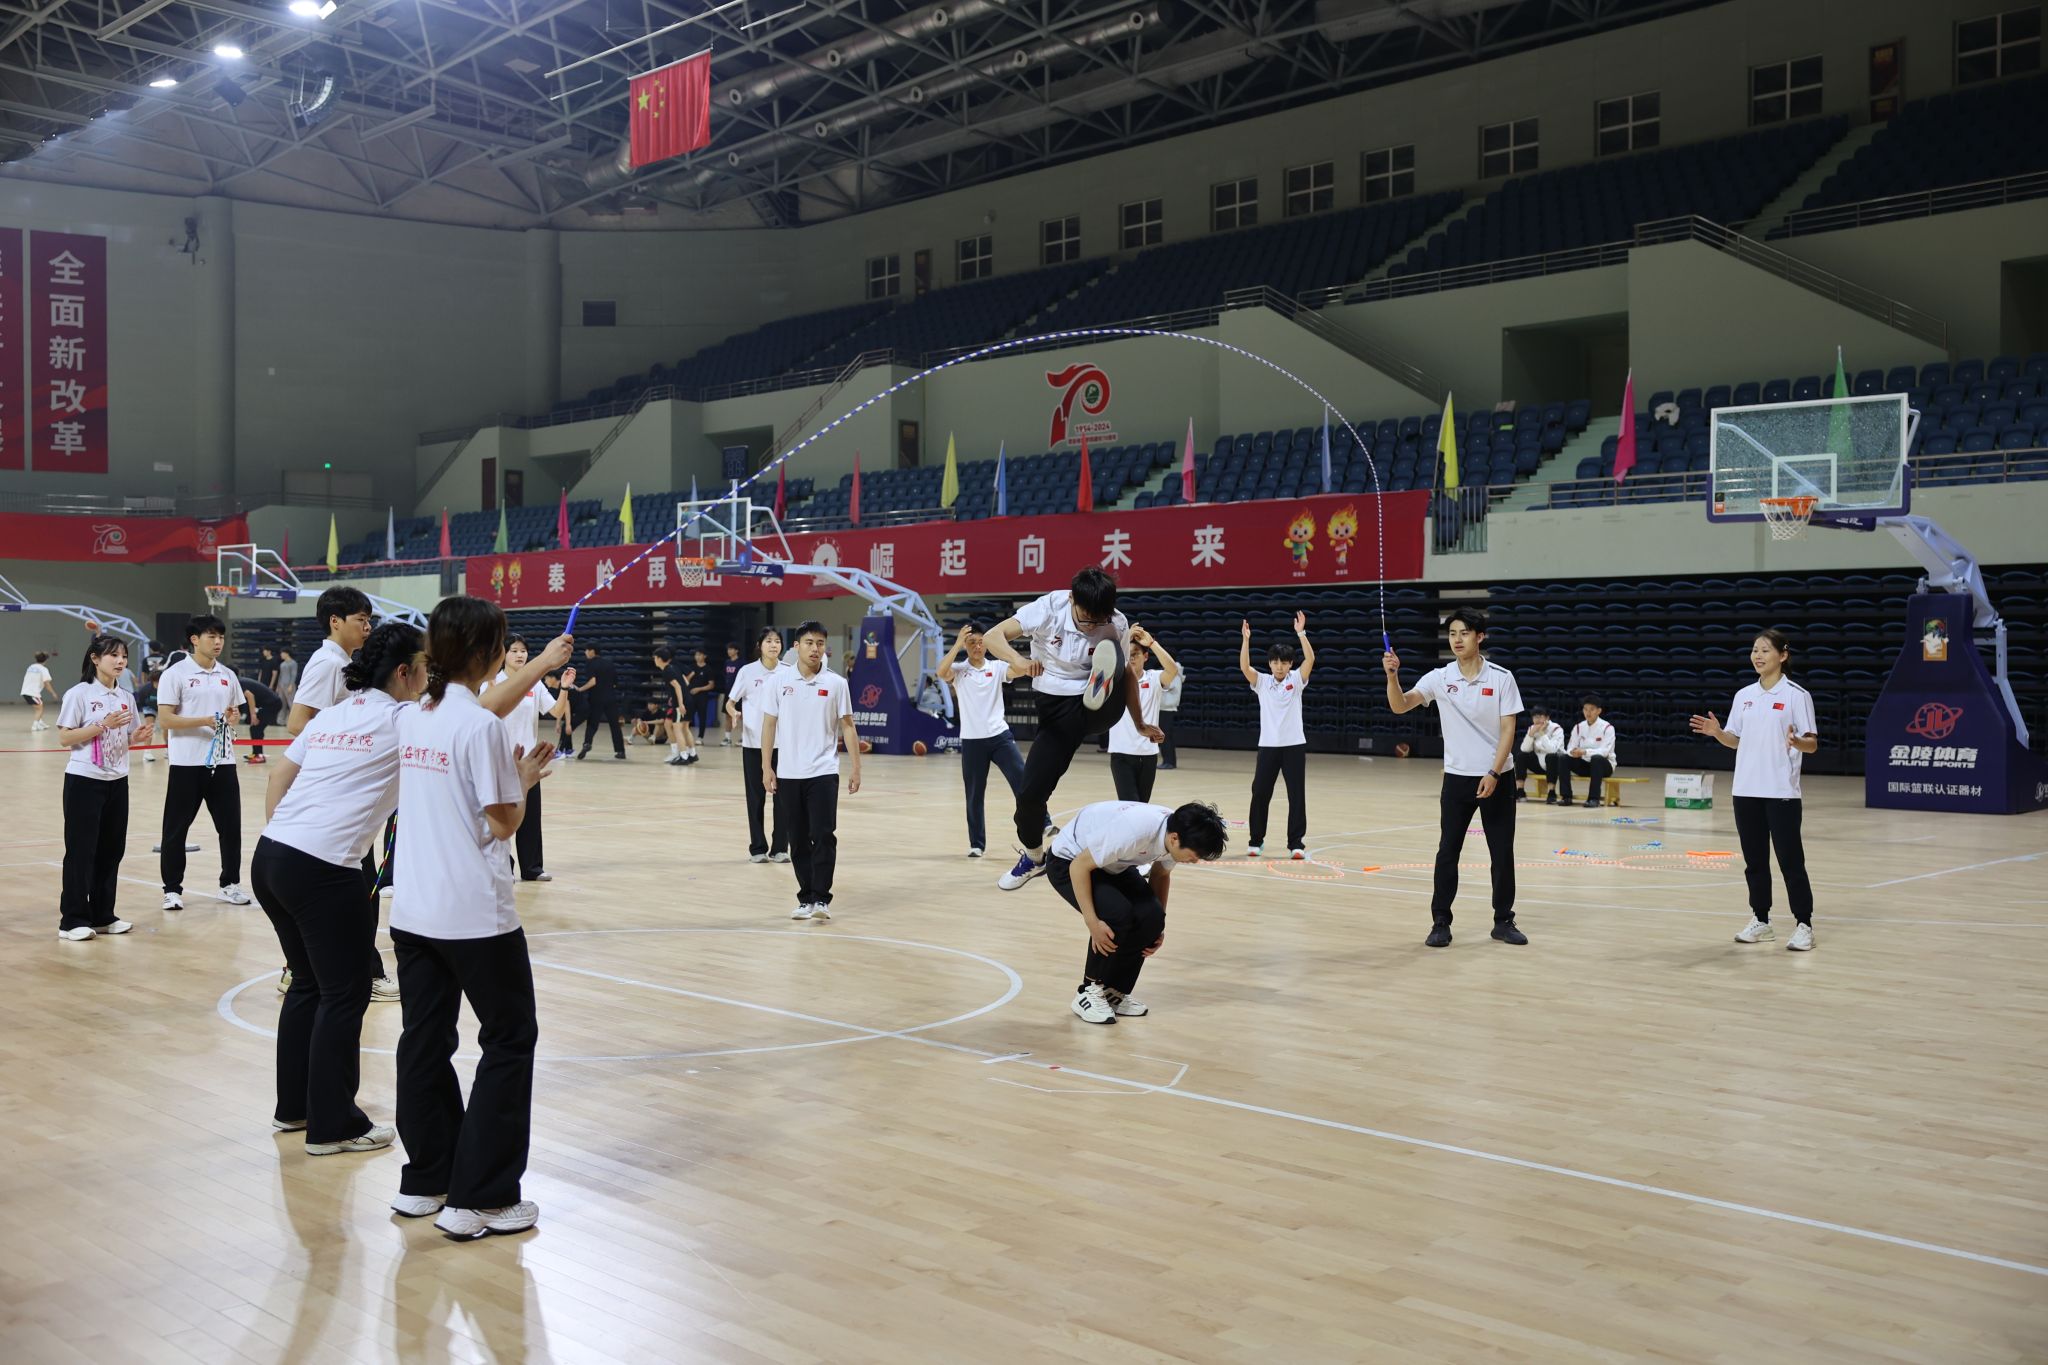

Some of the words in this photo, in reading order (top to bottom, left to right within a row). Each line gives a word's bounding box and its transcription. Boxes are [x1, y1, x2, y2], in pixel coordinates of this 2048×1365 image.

[48, 250, 87, 456] 全面新改革
[870, 524, 1225, 579] 崛起向未来
[1889, 745, 1978, 762] 金陵体育
[1932, 761, 1976, 769] SPORTS
[1888, 781, 1983, 797] 国际篮联认证器材
